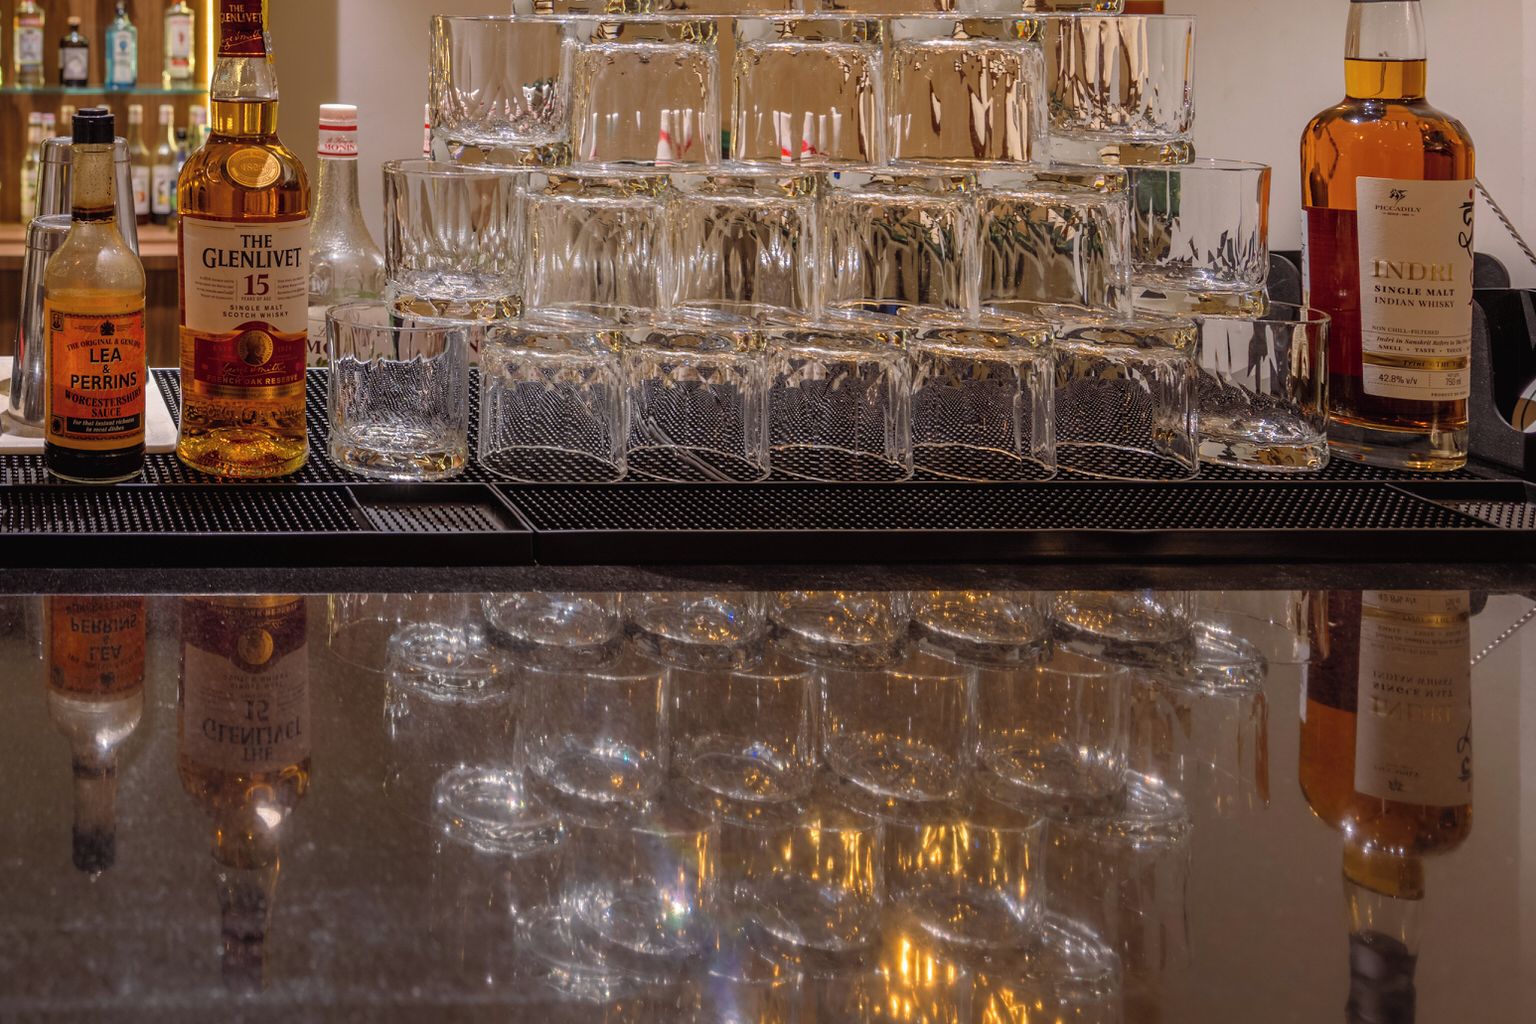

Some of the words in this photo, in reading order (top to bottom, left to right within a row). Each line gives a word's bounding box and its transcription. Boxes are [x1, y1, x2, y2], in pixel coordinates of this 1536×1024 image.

[228, 4, 245, 12] THE
[324, 143, 355, 152] MONIN
[1375, 204, 1422, 213] PICCADILY
[240, 234, 273, 249] THE
[202, 247, 302, 269] GLENLIVET
[1371, 258, 1455, 282] INDRI
[243, 273, 270, 296] 15
[1374, 284, 1422, 296] SINGLE
[1426, 288, 1455, 297] MALT
[1374, 296, 1415, 307] INDIAN
[1418, 300, 1455, 308] WHISKY
[229, 304, 261, 312] SINGLE
[222, 311, 257, 319] SCOTCH
[259, 311, 289, 319] WHISKY
[67, 342, 80, 351] THE
[80, 338, 113, 347] ORIGINAL
[1404, 338, 1432, 346] Sanskrit
[89, 347, 122, 363] LEA
[102, 364, 110, 374] &
[71, 371, 137, 390] PERRINS
[205, 374, 242, 385] FRENCH
[265, 374, 299, 384] RESERVE
[1378, 374, 1405, 384] 42.8%
[65, 387, 142, 408] WORCESTERSHIRE
[91, 406, 122, 417] SAUCE
